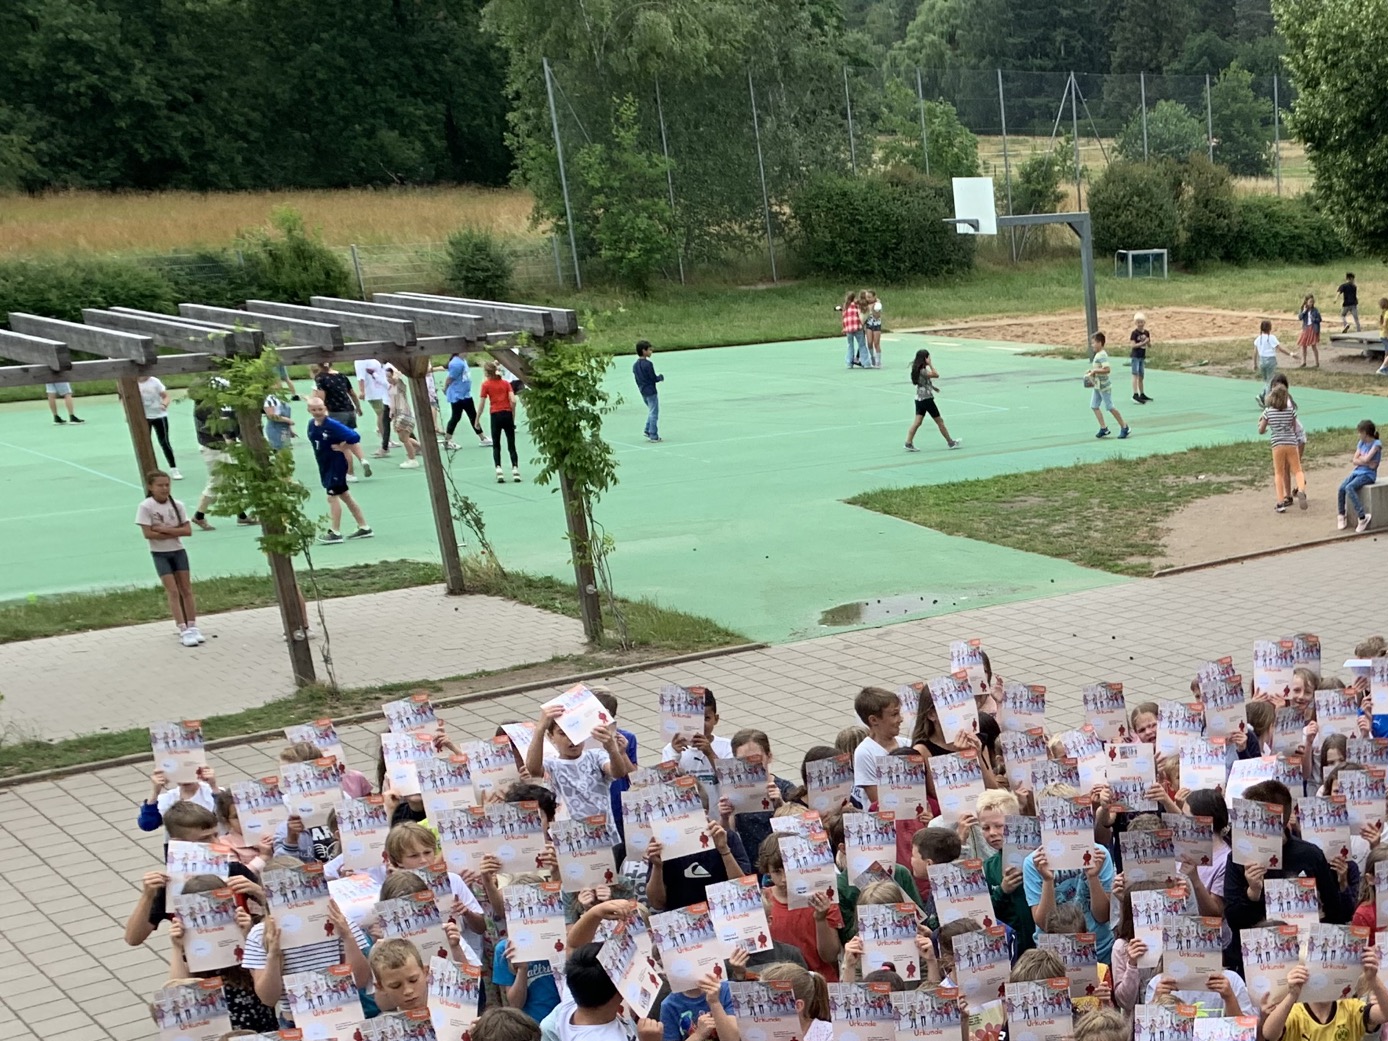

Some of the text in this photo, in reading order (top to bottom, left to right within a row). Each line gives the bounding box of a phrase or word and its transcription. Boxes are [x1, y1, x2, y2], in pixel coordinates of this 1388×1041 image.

[287, 900, 314, 909] Urkunde
[725, 913, 749, 921] Urkunde
[401, 928, 428, 938] Urkunde
[677, 944, 703, 953] Urkunde
[972, 964, 995, 973] Urkunde
[314, 1007, 342, 1016] Urkunde
[179, 1020, 210, 1030] Urkunde
[1027, 1019, 1054, 1027] Urkunde
